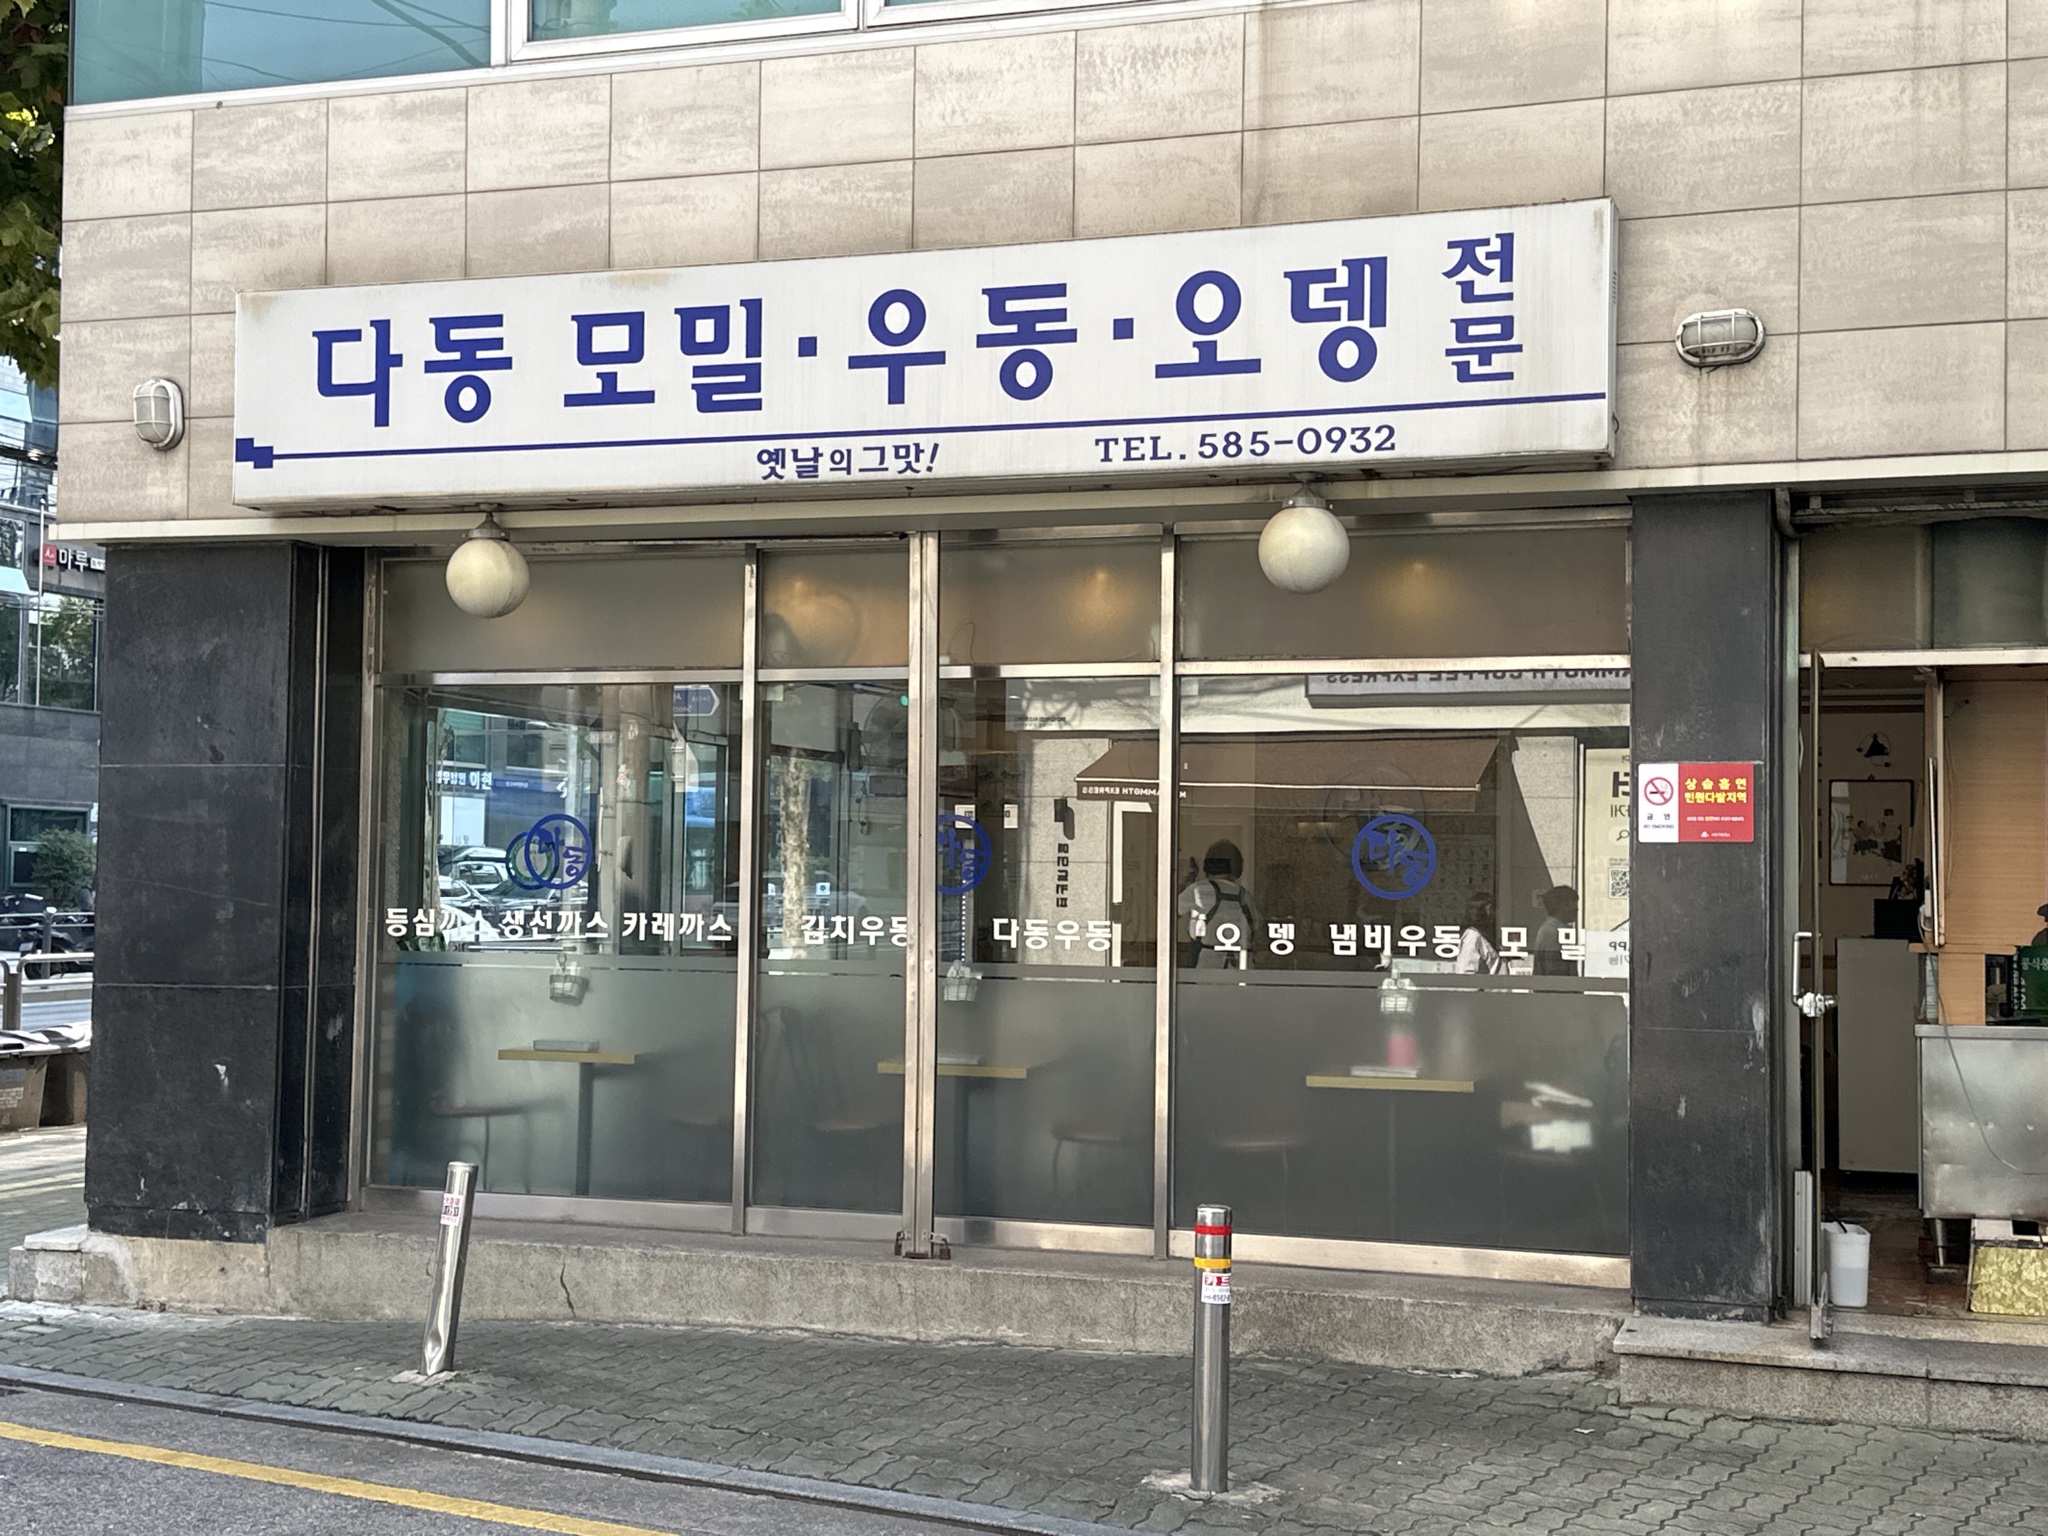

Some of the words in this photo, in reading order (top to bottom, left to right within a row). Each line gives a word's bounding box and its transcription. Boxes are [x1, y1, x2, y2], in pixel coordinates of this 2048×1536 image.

[1442, 232, 1524, 383] 전문
[312, 312, 513, 428] 다동
[58, 548, 89, 572] 마루
[502, 910, 609, 939] 생선까스
[622, 912, 732, 942] 카레까스
[992, 917, 1113, 951] 다동우동
[1329, 924, 1461, 958] 냄비우동
